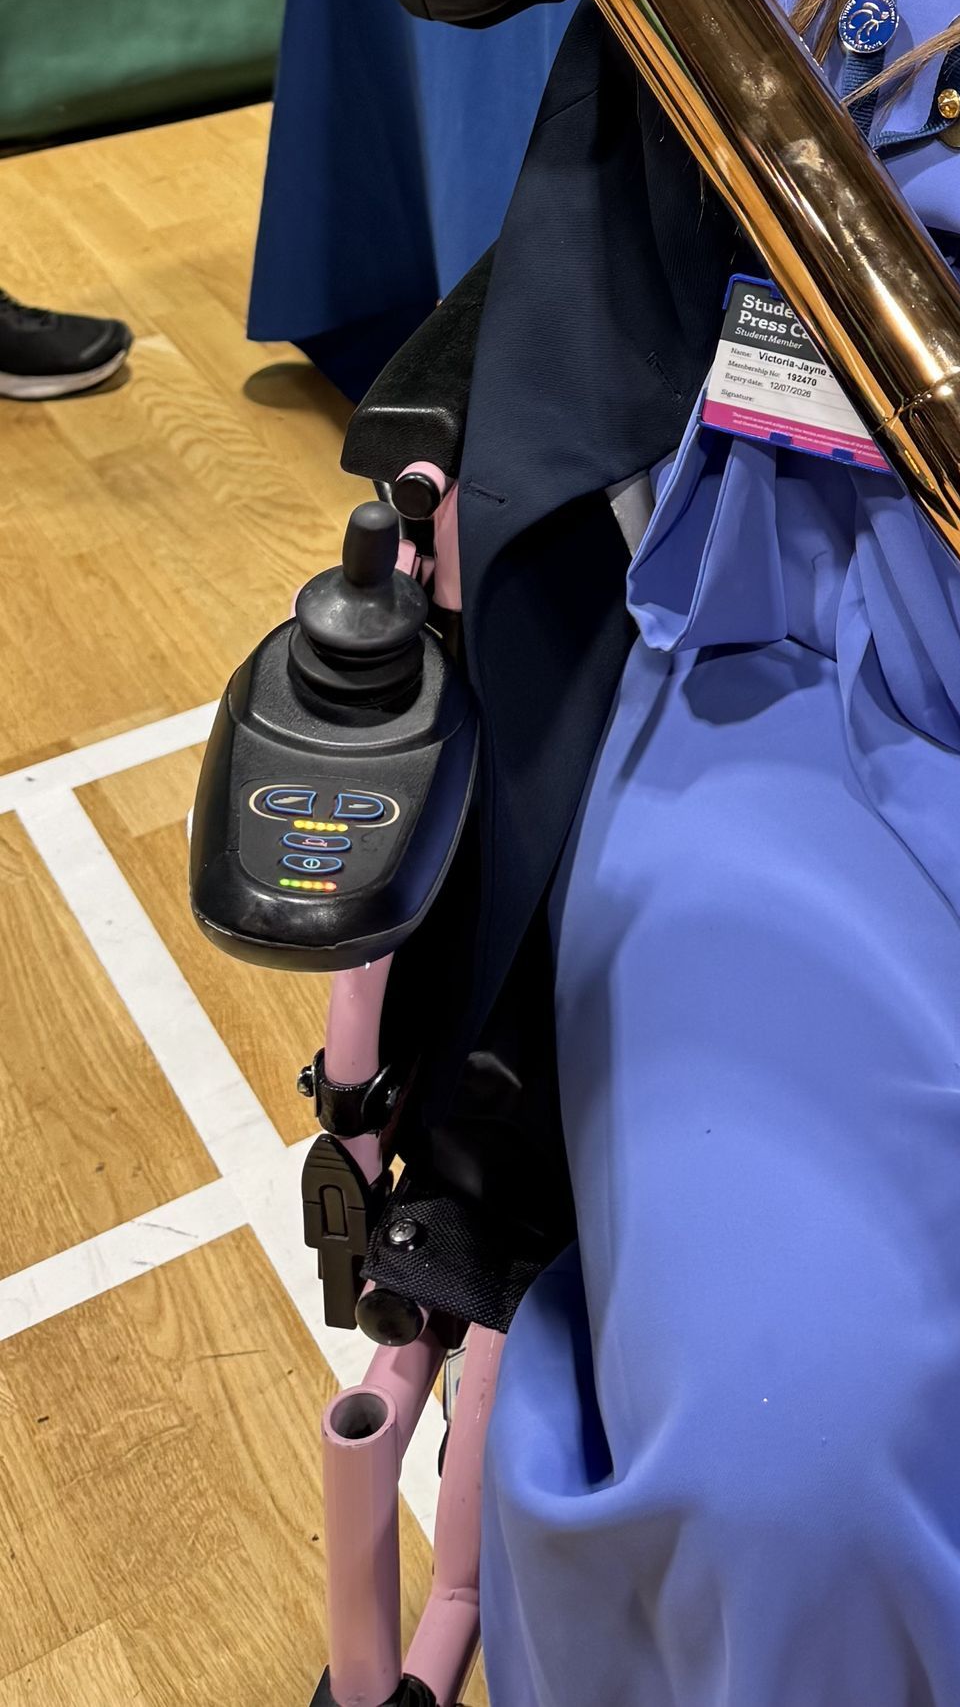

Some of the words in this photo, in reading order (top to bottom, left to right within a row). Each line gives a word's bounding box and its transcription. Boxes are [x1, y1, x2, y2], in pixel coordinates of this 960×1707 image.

[742, 294, 797, 319] Stude
[738, 310, 787, 334] Press
[735, 326, 767, 342] Student
[768, 335, 803, 349] Member
[727, 360, 768, 376] Membership
[787, 372, 817, 387] 192470
[758, 351, 827, 376] Victoria-Jayne
[724, 373, 747, 385] Expiry
